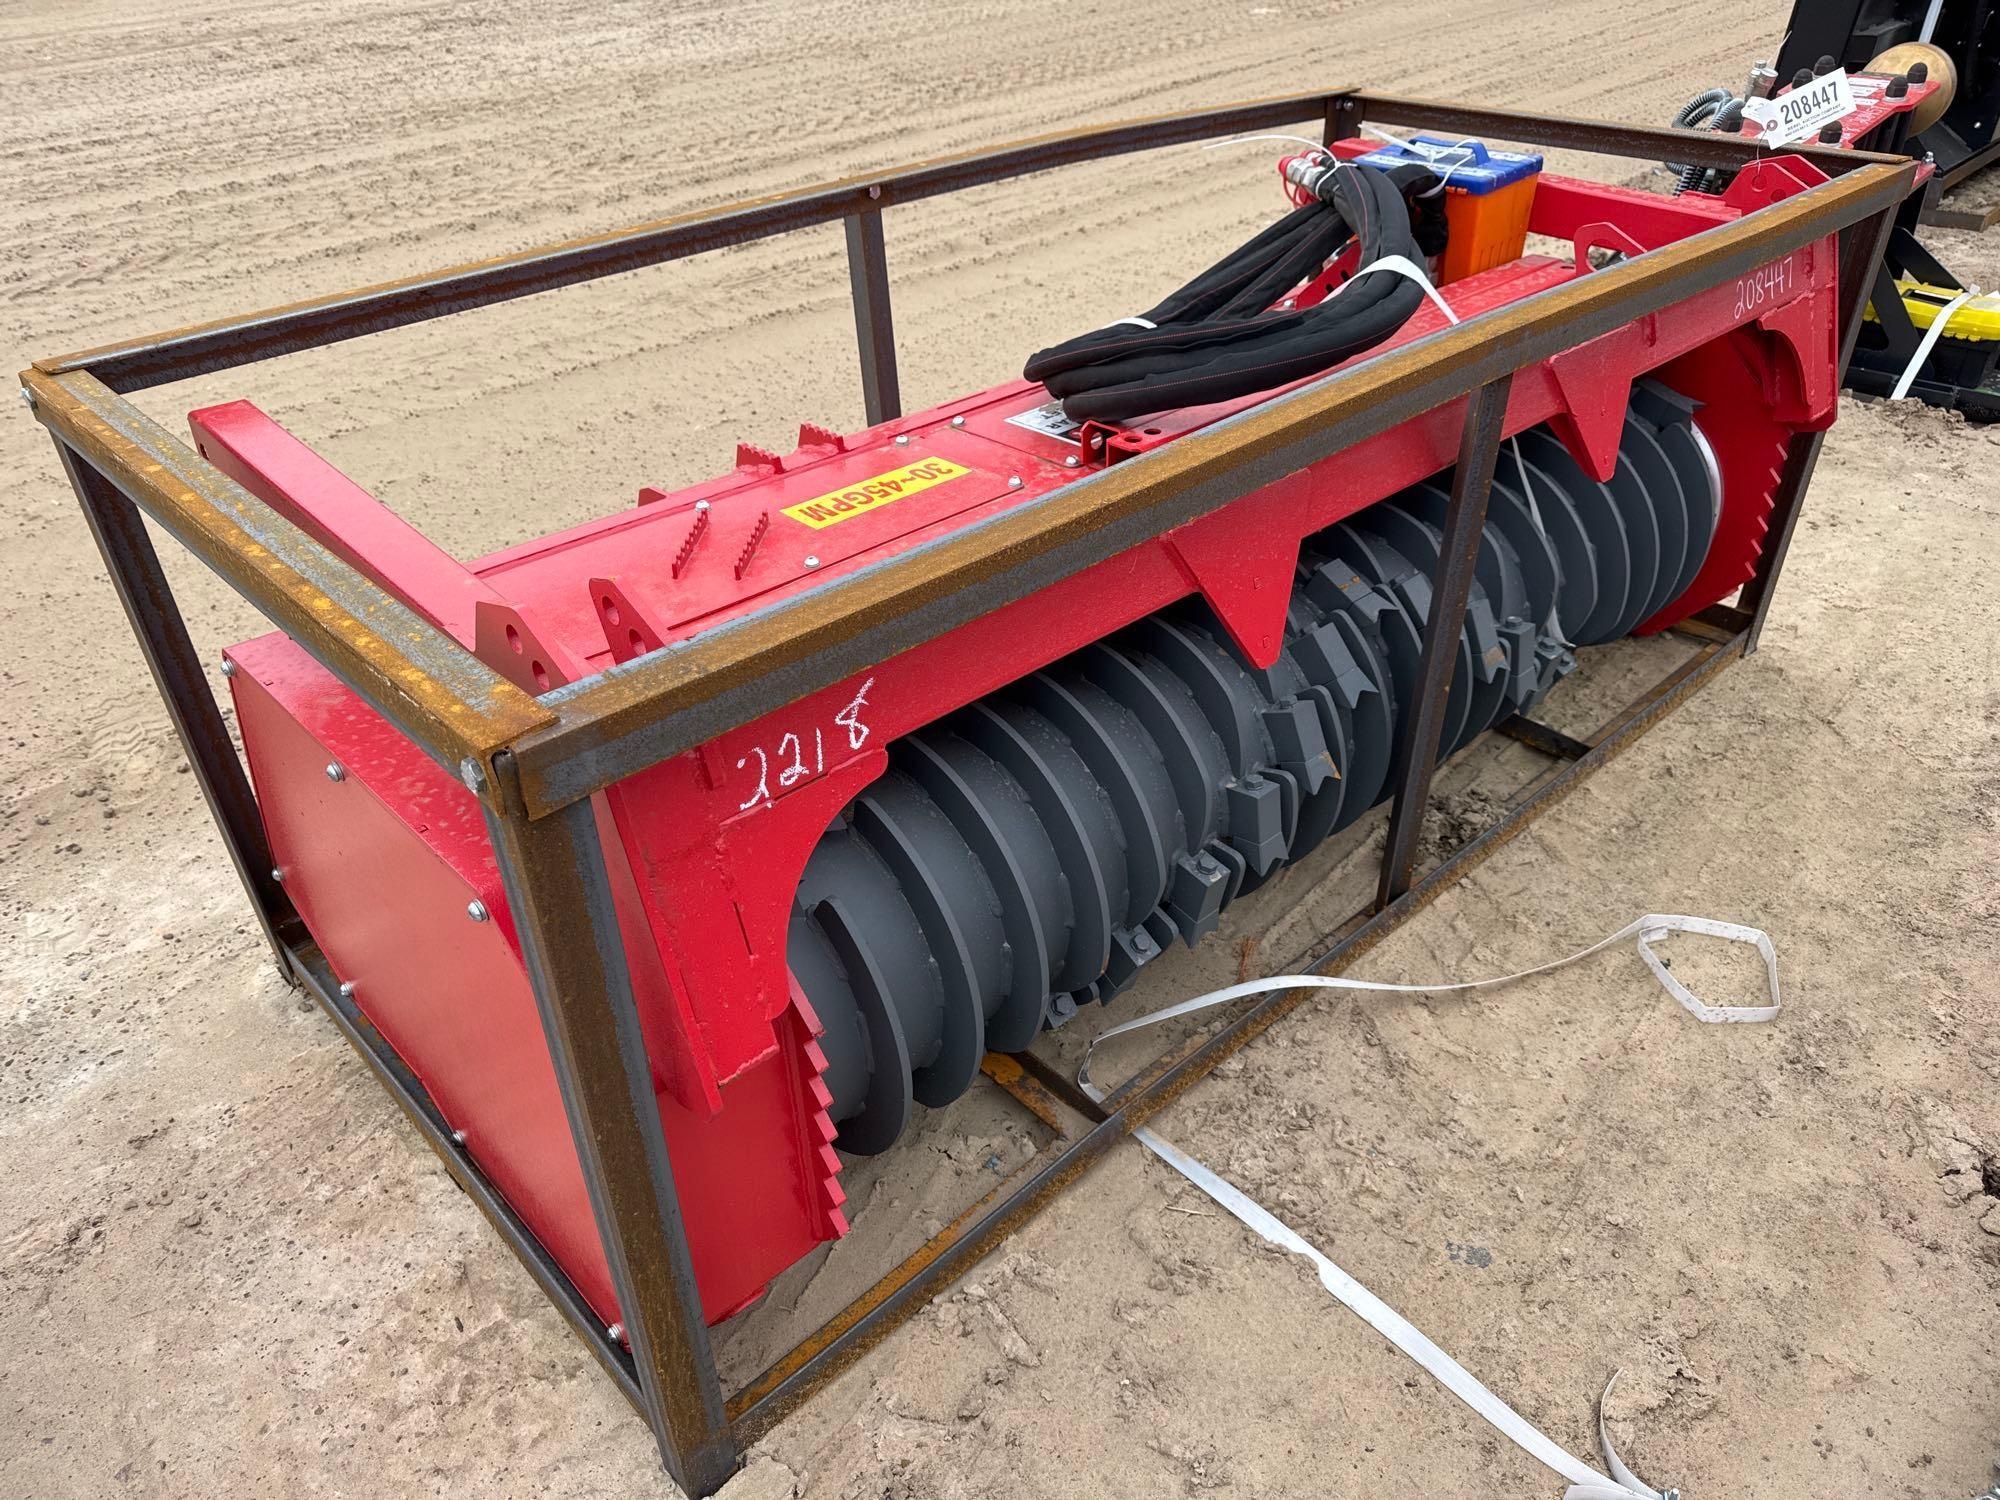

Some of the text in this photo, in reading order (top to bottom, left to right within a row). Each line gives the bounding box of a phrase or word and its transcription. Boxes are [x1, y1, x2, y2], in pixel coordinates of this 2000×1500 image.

[1780, 81, 1838, 125] 208447
[1802, 113, 1820, 124] AUCTION
[1820, 104, 1841, 117] COMPANY
[1734, 256, 1793, 320] 208447
[736, 676, 875, 810] 2218
